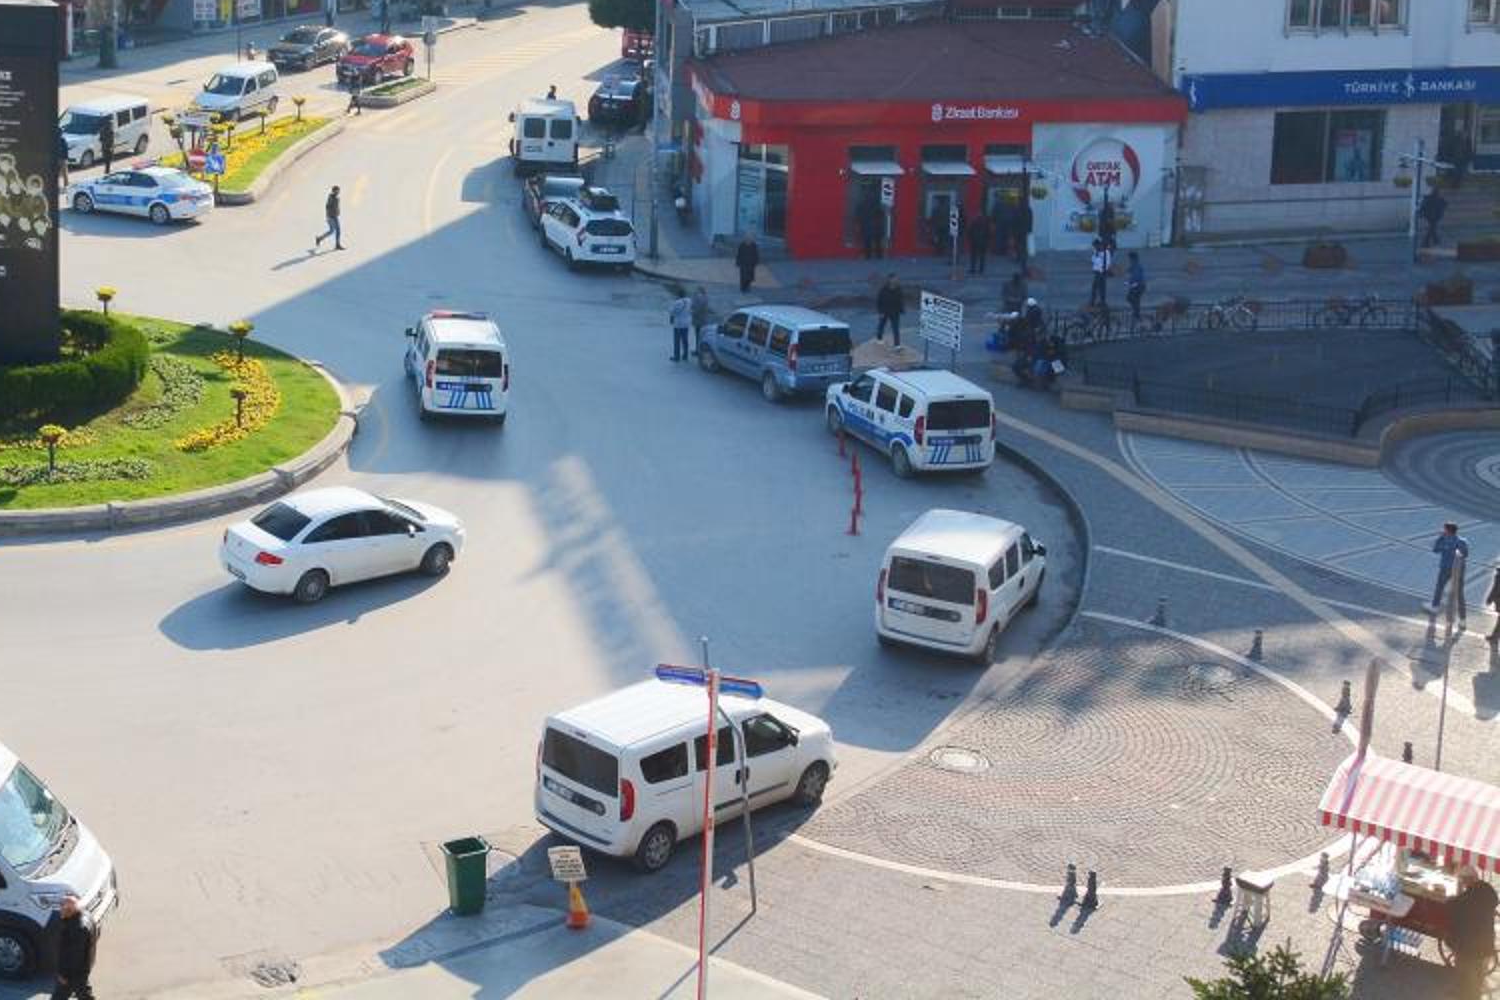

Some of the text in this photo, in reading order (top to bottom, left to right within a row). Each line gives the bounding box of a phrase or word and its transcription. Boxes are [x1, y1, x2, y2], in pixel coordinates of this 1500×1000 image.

[1343, 79, 1476, 94] TÜRKİYE BANKASI
[1086, 171, 1121, 187] ATM
